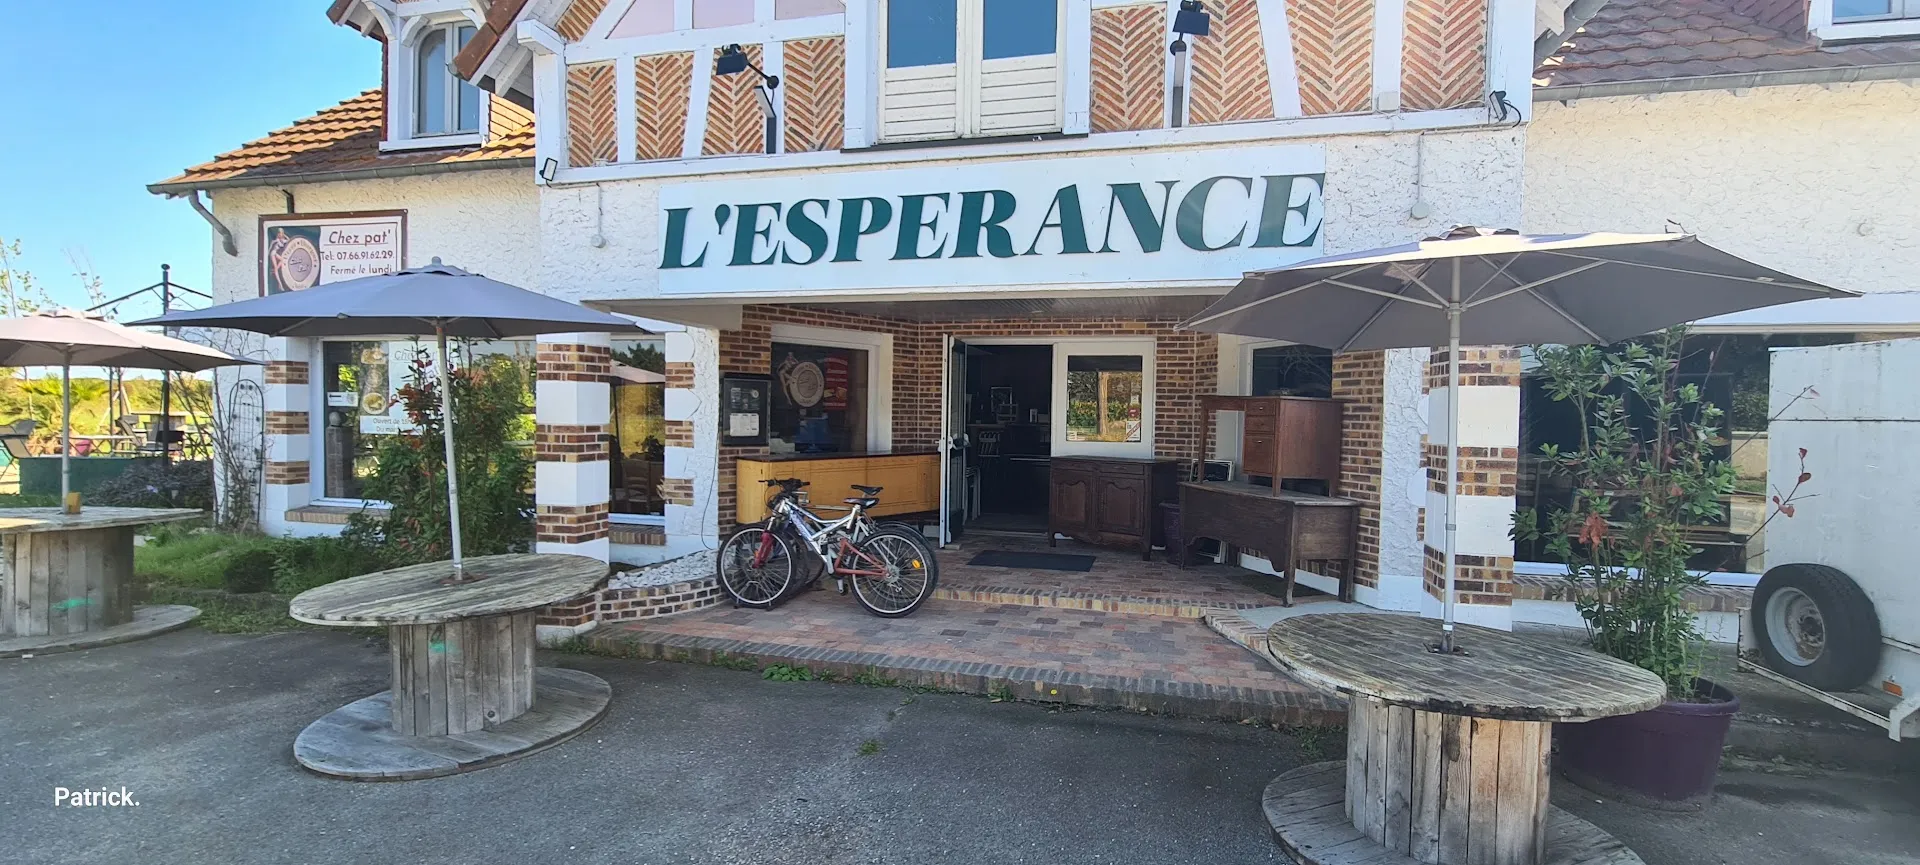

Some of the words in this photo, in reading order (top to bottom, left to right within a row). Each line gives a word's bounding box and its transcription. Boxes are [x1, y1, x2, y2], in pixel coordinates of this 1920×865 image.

[657, 172, 1326, 269] L'ESPERANCE
[328, 229, 360, 244] Chez
[364, 228, 391, 247] pat'
[358, 263, 366, 274] le
